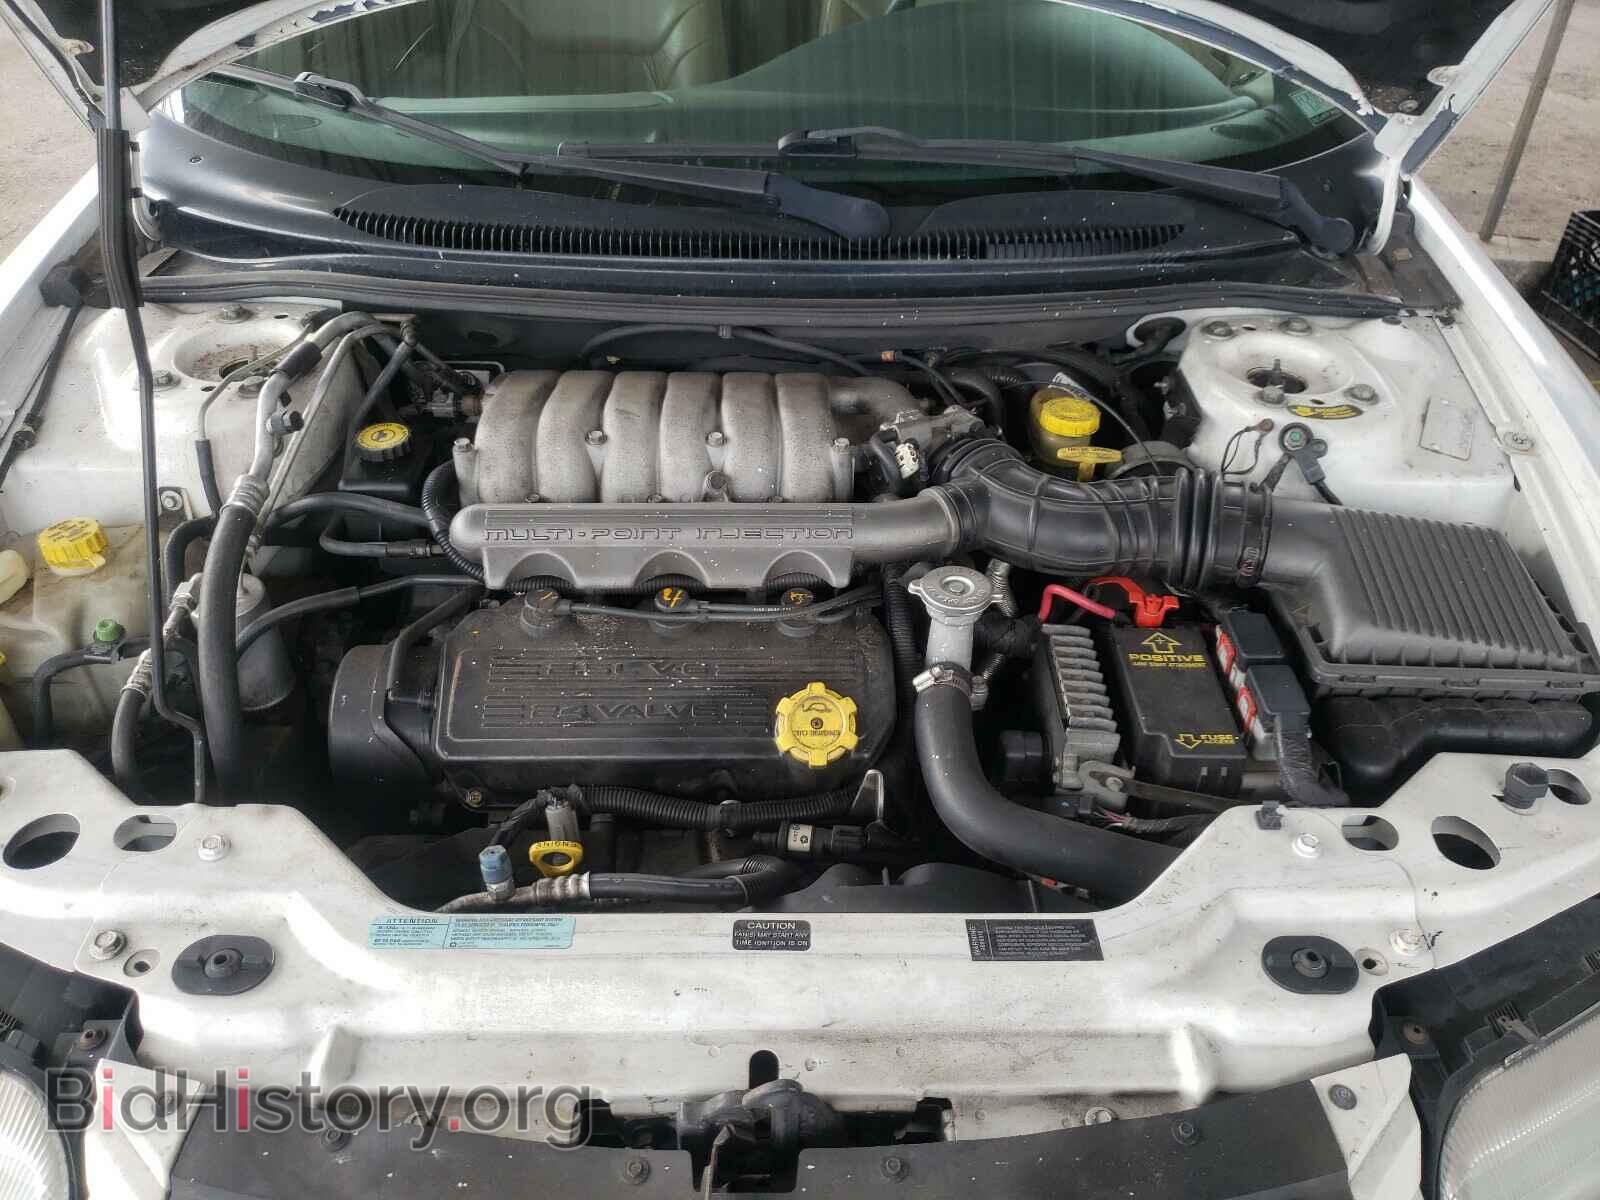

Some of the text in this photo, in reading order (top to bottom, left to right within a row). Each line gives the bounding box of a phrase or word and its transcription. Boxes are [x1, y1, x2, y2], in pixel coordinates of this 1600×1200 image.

[696, 527, 853, 540] INJECTION
[1128, 653, 1206, 662] POSITIVE
[747, 922, 796, 930] CAUTION
